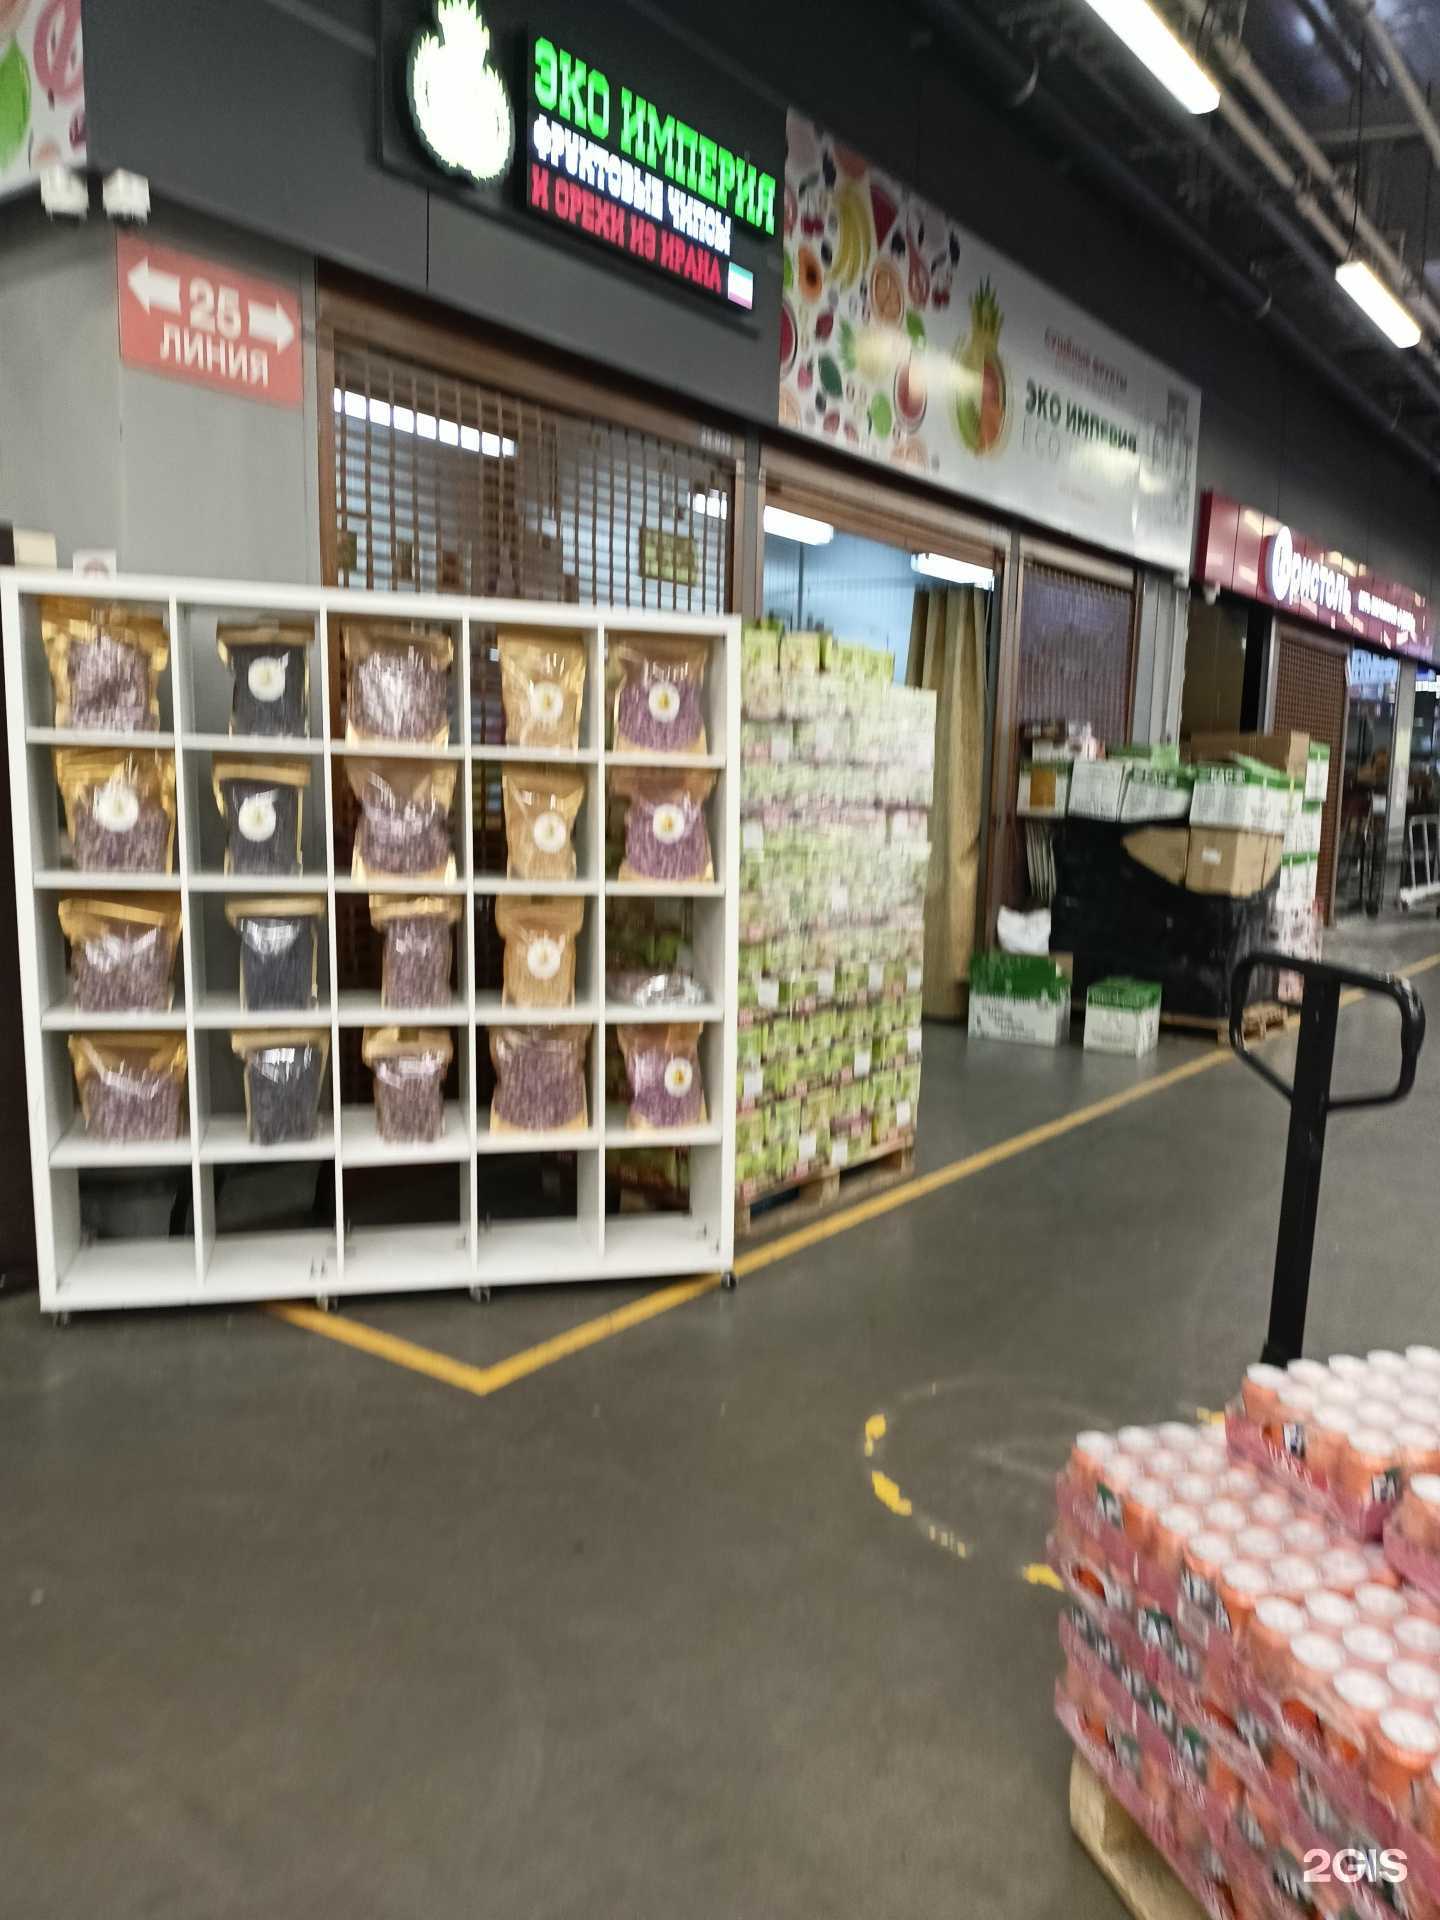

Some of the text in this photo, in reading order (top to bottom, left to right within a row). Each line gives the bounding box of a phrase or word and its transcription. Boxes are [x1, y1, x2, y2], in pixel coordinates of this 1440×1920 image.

[533, 113, 731, 257] ФРУКТОВЫЕ ЧИПСЫ
[534, 36, 776, 237] ЭКО ИМПЕРИЯ
[531, 163, 722, 294] И ОРЕХИ ИЗ ИРАНА
[160, 320, 270, 387] ЛИНИЯ
[189, 277, 242, 340] 25
[1025, 377, 1062, 426] ЭКО
